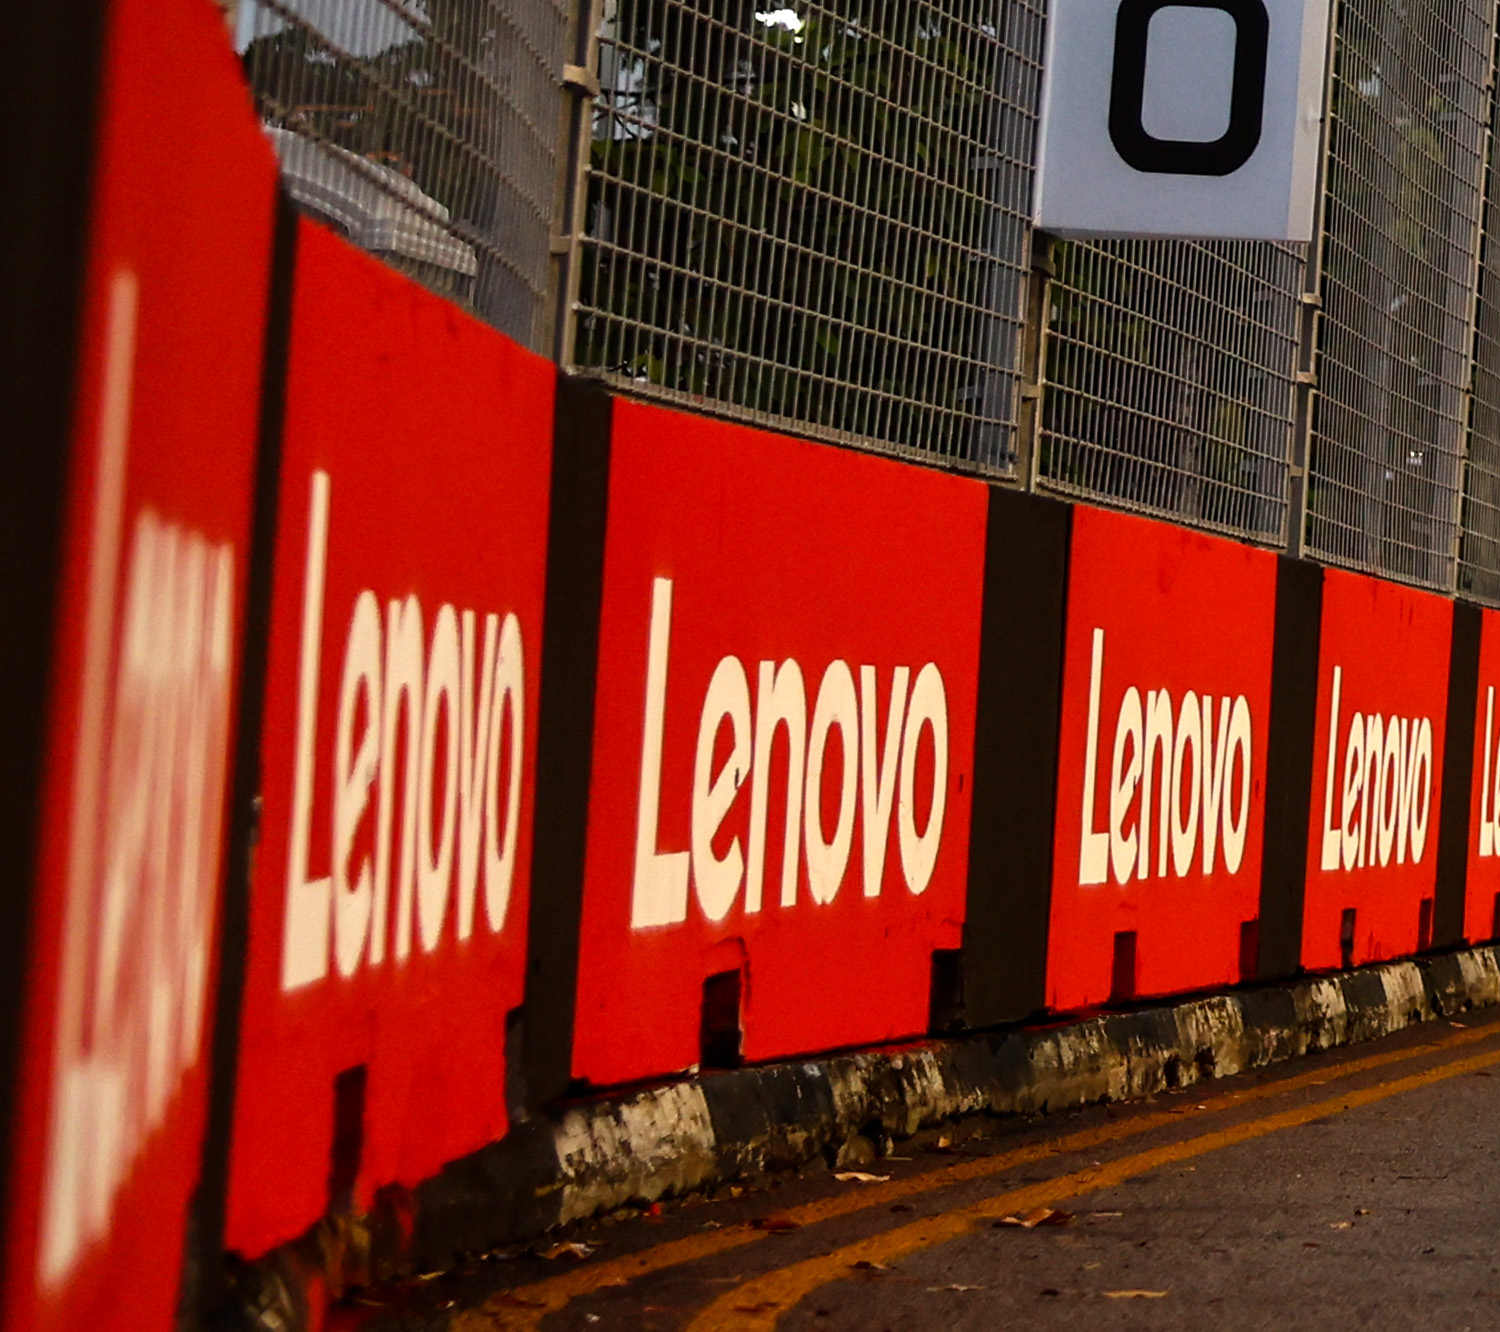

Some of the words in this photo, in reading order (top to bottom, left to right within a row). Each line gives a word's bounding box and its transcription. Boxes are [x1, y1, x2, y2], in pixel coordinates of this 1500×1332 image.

[281, 469, 525, 993] Lenovo
[630, 576, 949, 930] Lenovo
[1078, 627, 1252, 887] Lenovo
[1320, 665, 1432, 872] Lenovo
